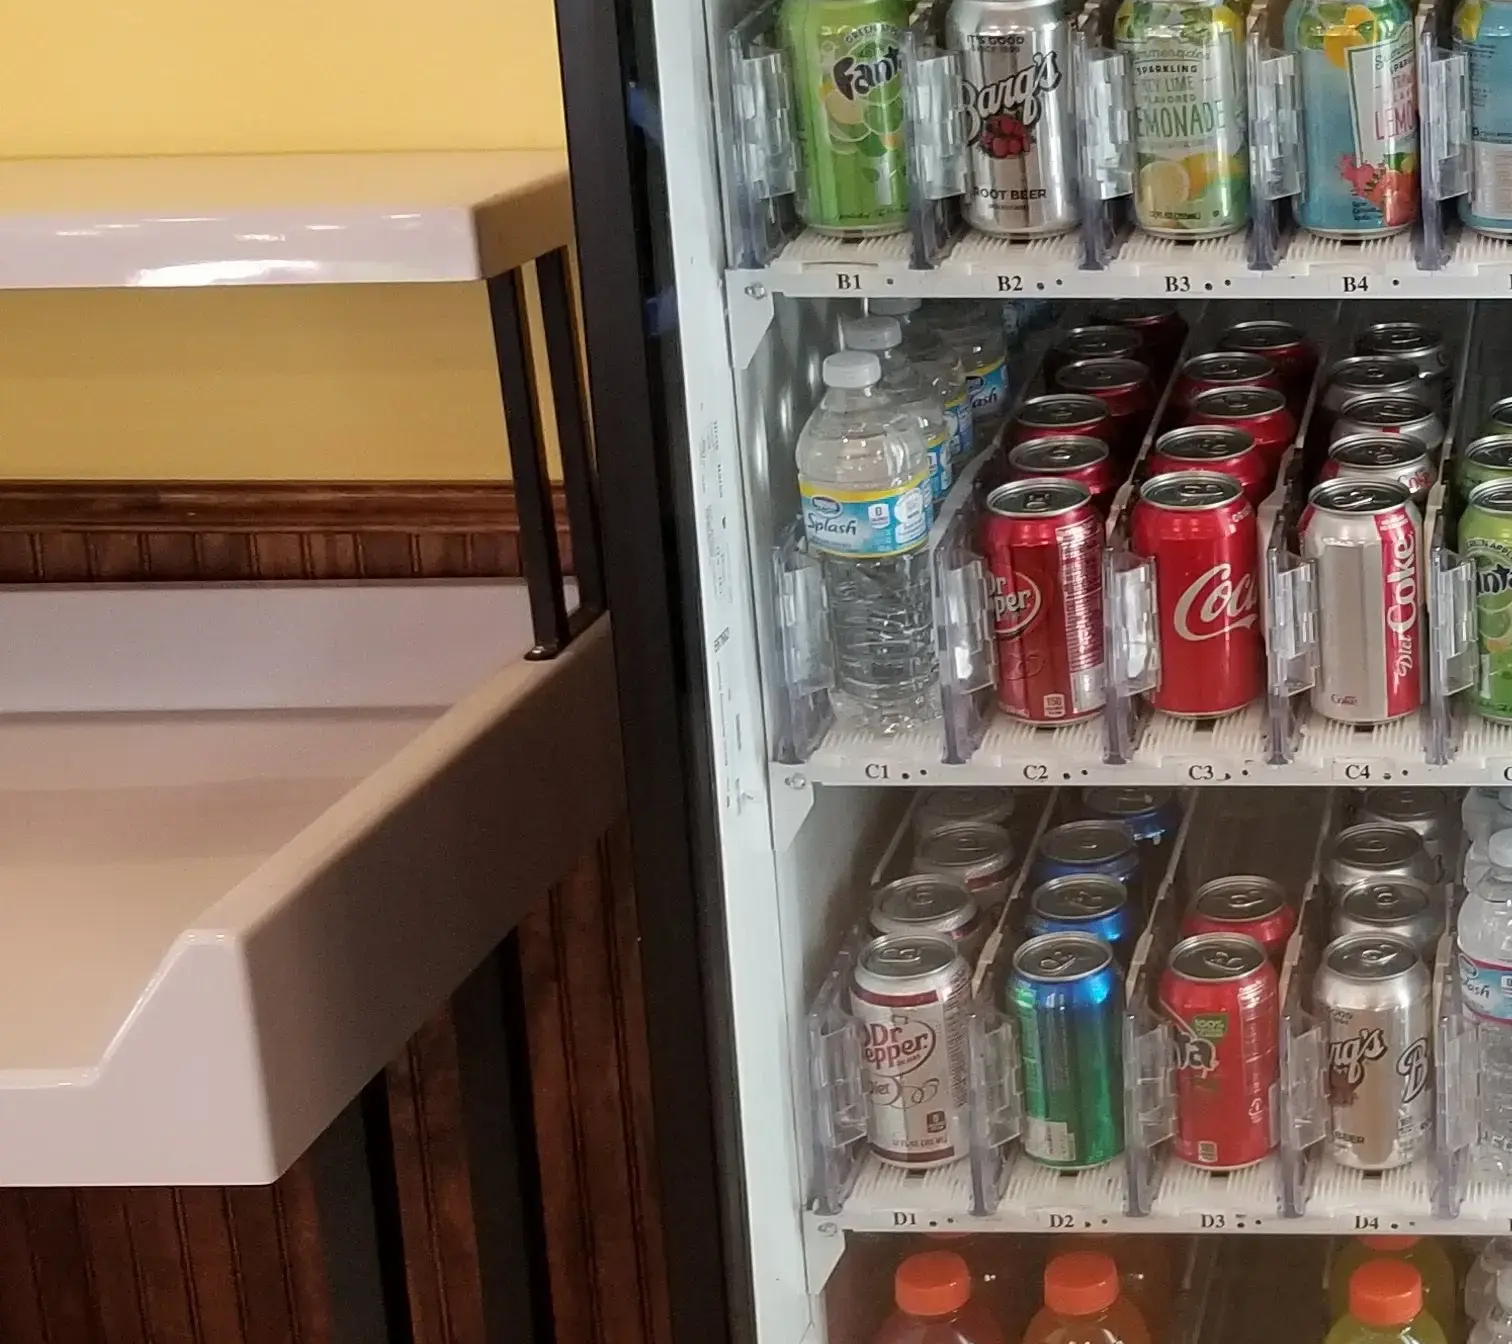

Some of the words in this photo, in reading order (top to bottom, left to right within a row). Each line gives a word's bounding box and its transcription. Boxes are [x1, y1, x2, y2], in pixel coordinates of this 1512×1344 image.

[989, 36, 1024, 45] GOOD
[833, 46, 902, 100] Fant
[1137, 65, 1197, 74] SPARKLING
[1166, 76, 1195, 92] LIME
[1137, 100, 1225, 138] EMONADE
[1011, 189, 1046, 200] BEER
[836, 274, 861, 290] B1
[997, 276, 1023, 292] B2
[1165, 276, 1191, 292] B3
[1343, 276, 1369, 292] B4
[808, 513, 856, 536] Splash
[1387, 531, 1417, 640] Coke
[865, 763, 890, 780] C1
[1022, 764, 1049, 781] C2
[1188, 764, 1215, 782] C3
[1345, 764, 1370, 779] C4
[870, 1023, 903, 1046] Dr
[893, 1212, 917, 1226] D1
[1049, 1214, 1074, 1228] D2
[1201, 1214, 1226, 1228] D3
[1354, 1216, 1379, 1231] D4
